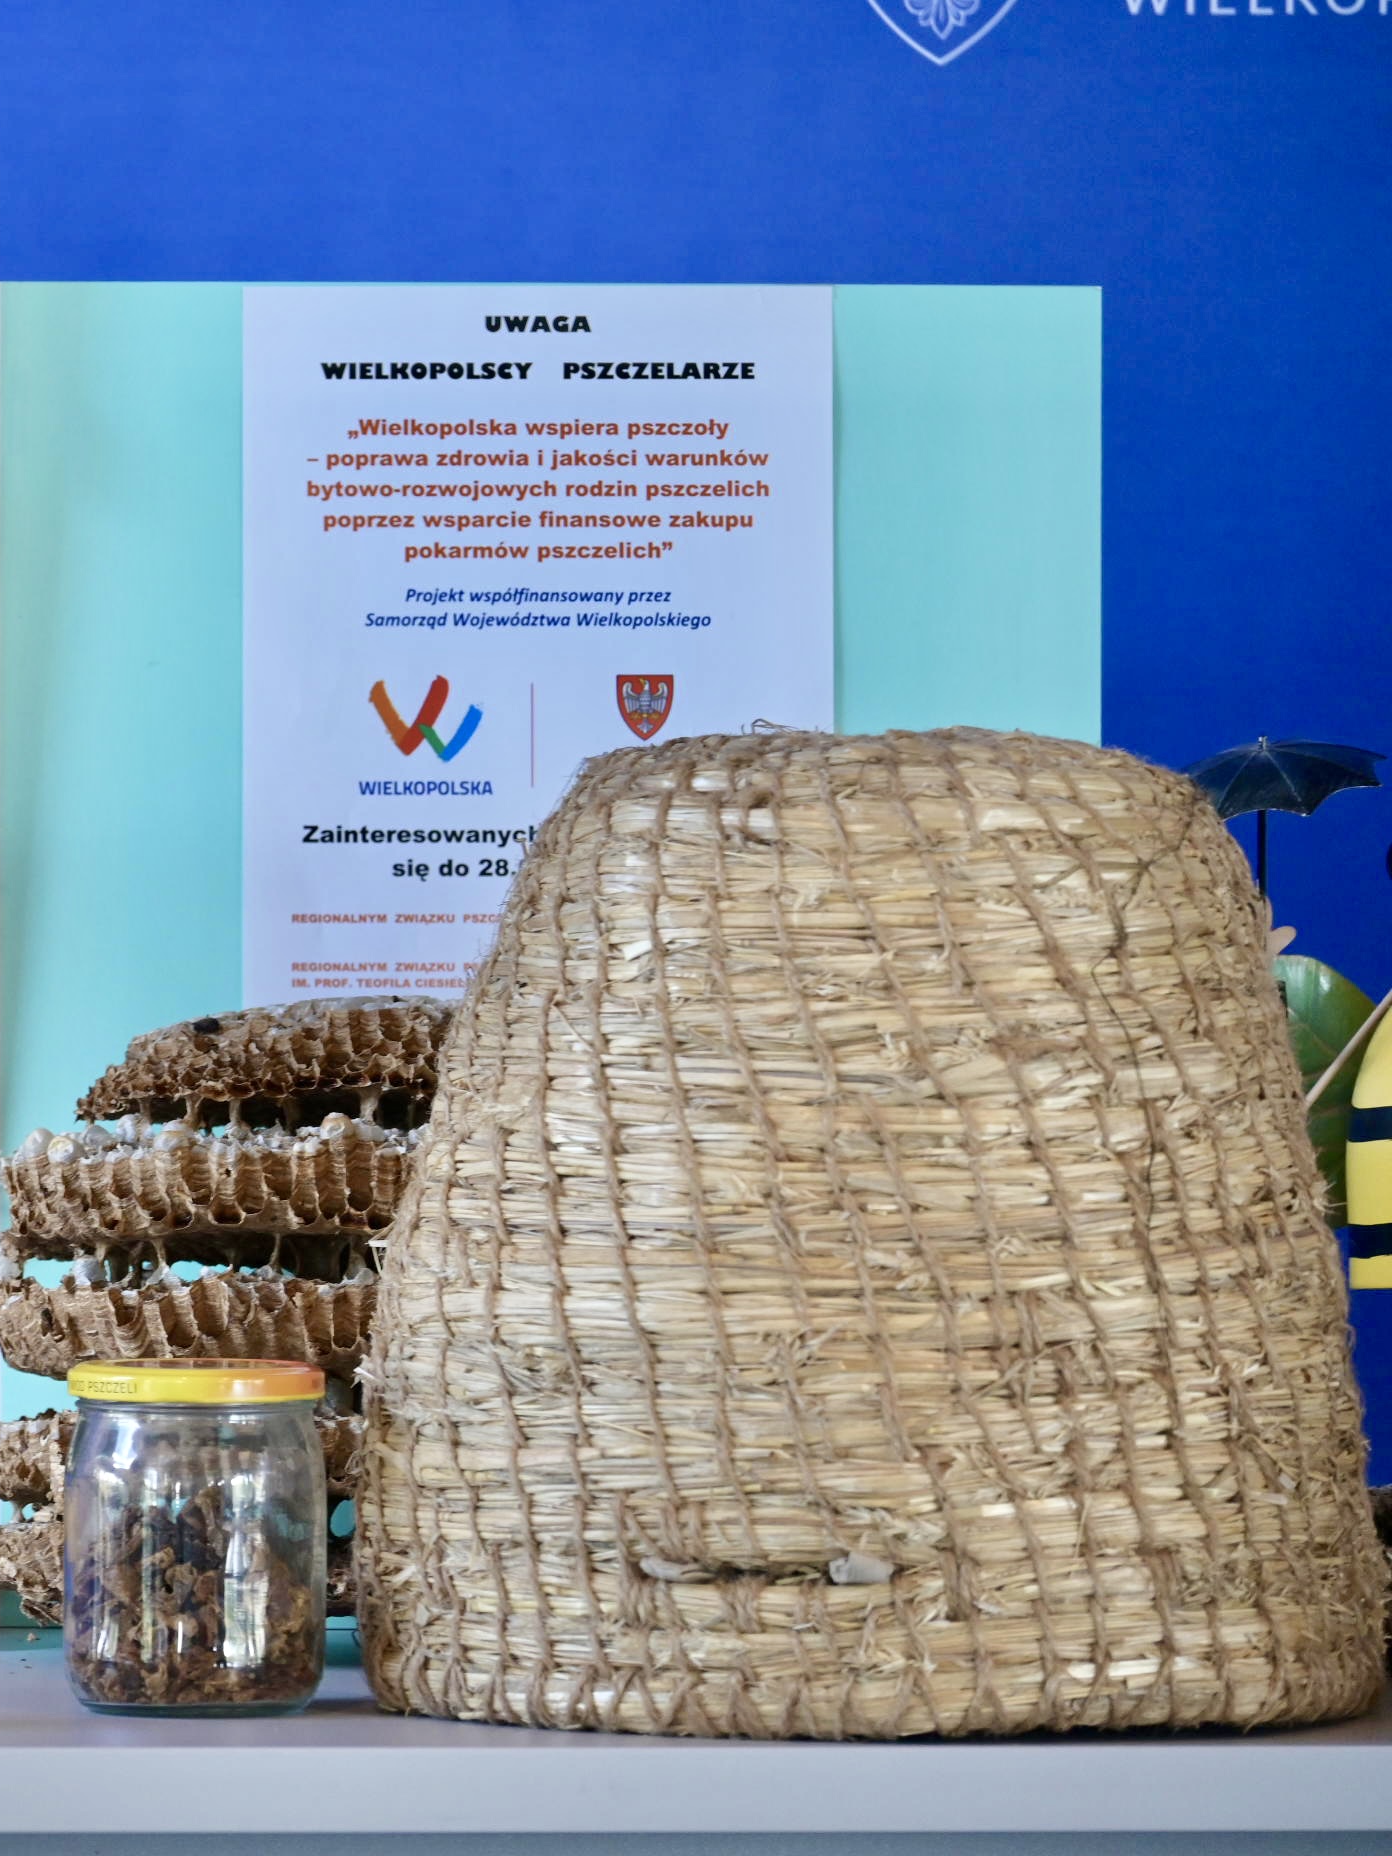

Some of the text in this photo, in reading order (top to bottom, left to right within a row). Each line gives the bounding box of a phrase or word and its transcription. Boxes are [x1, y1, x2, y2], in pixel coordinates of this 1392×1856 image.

[484, 314, 593, 334] UWAGA
[319, 361, 756, 381] WIELKOPOLSCY PSZCZELARZE
[524, 418, 619, 440] wspiera
[627, 418, 730, 440] pszczoły
[326, 452, 429, 471] poprawa
[435, 449, 529, 467] zdrowia
[537, 449, 544, 467] i
[549, 448, 638, 471] jakości
[644, 448, 769, 467] warunków
[306, 479, 770, 502] bytowo-rozwojowych rodzin pszczelich
[323, 510, 753, 533] poprzez wsparcie finansowe zakupu
[404, 541, 530, 564] pokarmów
[404, 586, 672, 607] Projekt współfinansowany przez
[364, 611, 712, 631] Samorząd Województwa Wielkopolskiego
[358, 780, 494, 796] WIELKOPOLSKA
[391, 858, 431, 883] się
[437, 858, 470, 878] do
[291, 913, 388, 924] REGIONALNYM
[394, 913, 456, 926] ZWIĄZKU
[291, 962, 388, 973] REGIONALNYM
[394, 962, 456, 975] ZWIĄZKU
[291, 978, 311, 988] IM.
[314, 978, 353, 988] PROF.
[357, 978, 411, 988] TEOFILA
